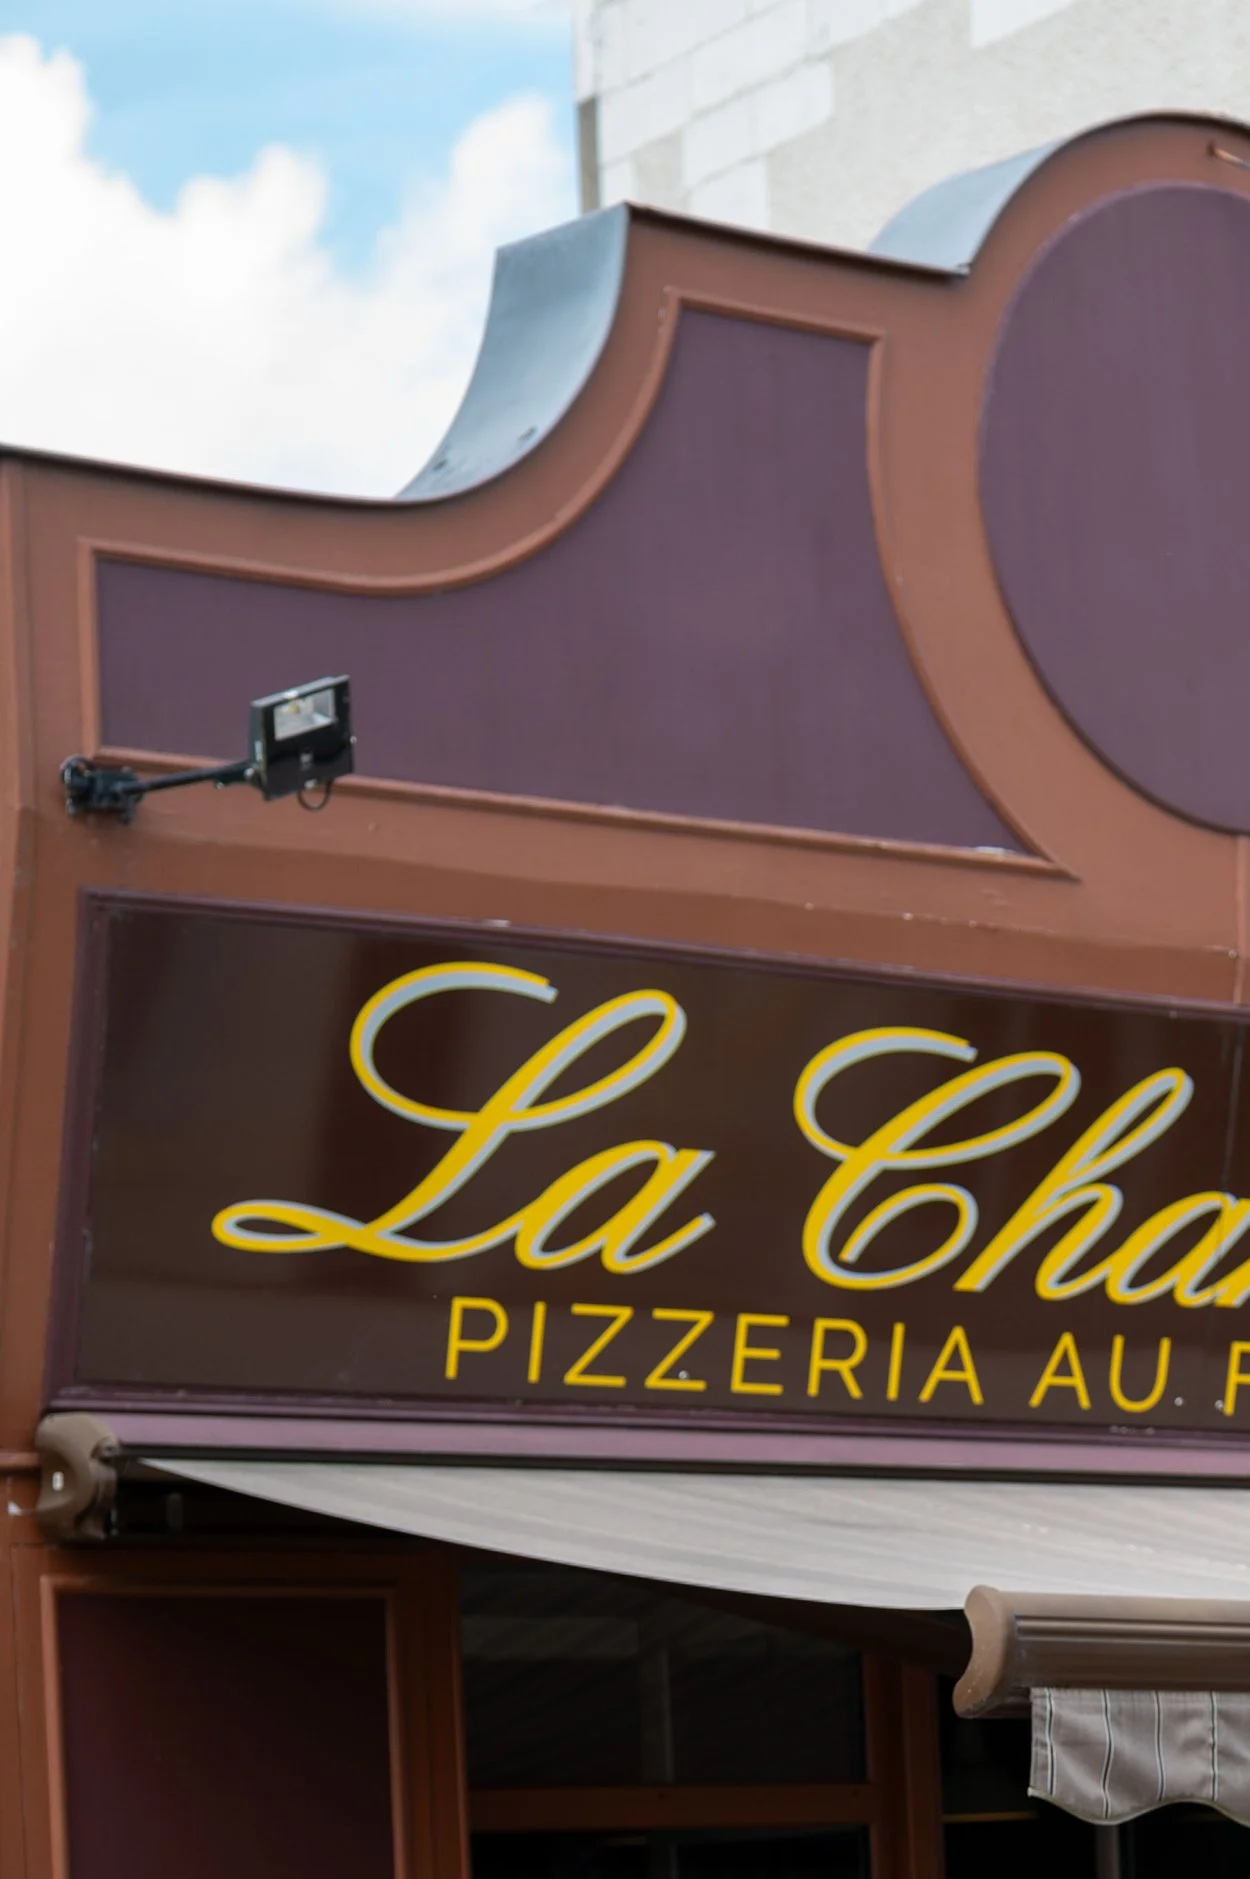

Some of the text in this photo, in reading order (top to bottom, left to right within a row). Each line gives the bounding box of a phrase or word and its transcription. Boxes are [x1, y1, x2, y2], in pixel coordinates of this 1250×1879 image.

[212, 960, 716, 1275] La
[445, 1296, 985, 1406] PIZZERIA
[1029, 1331, 1172, 1413] AU
